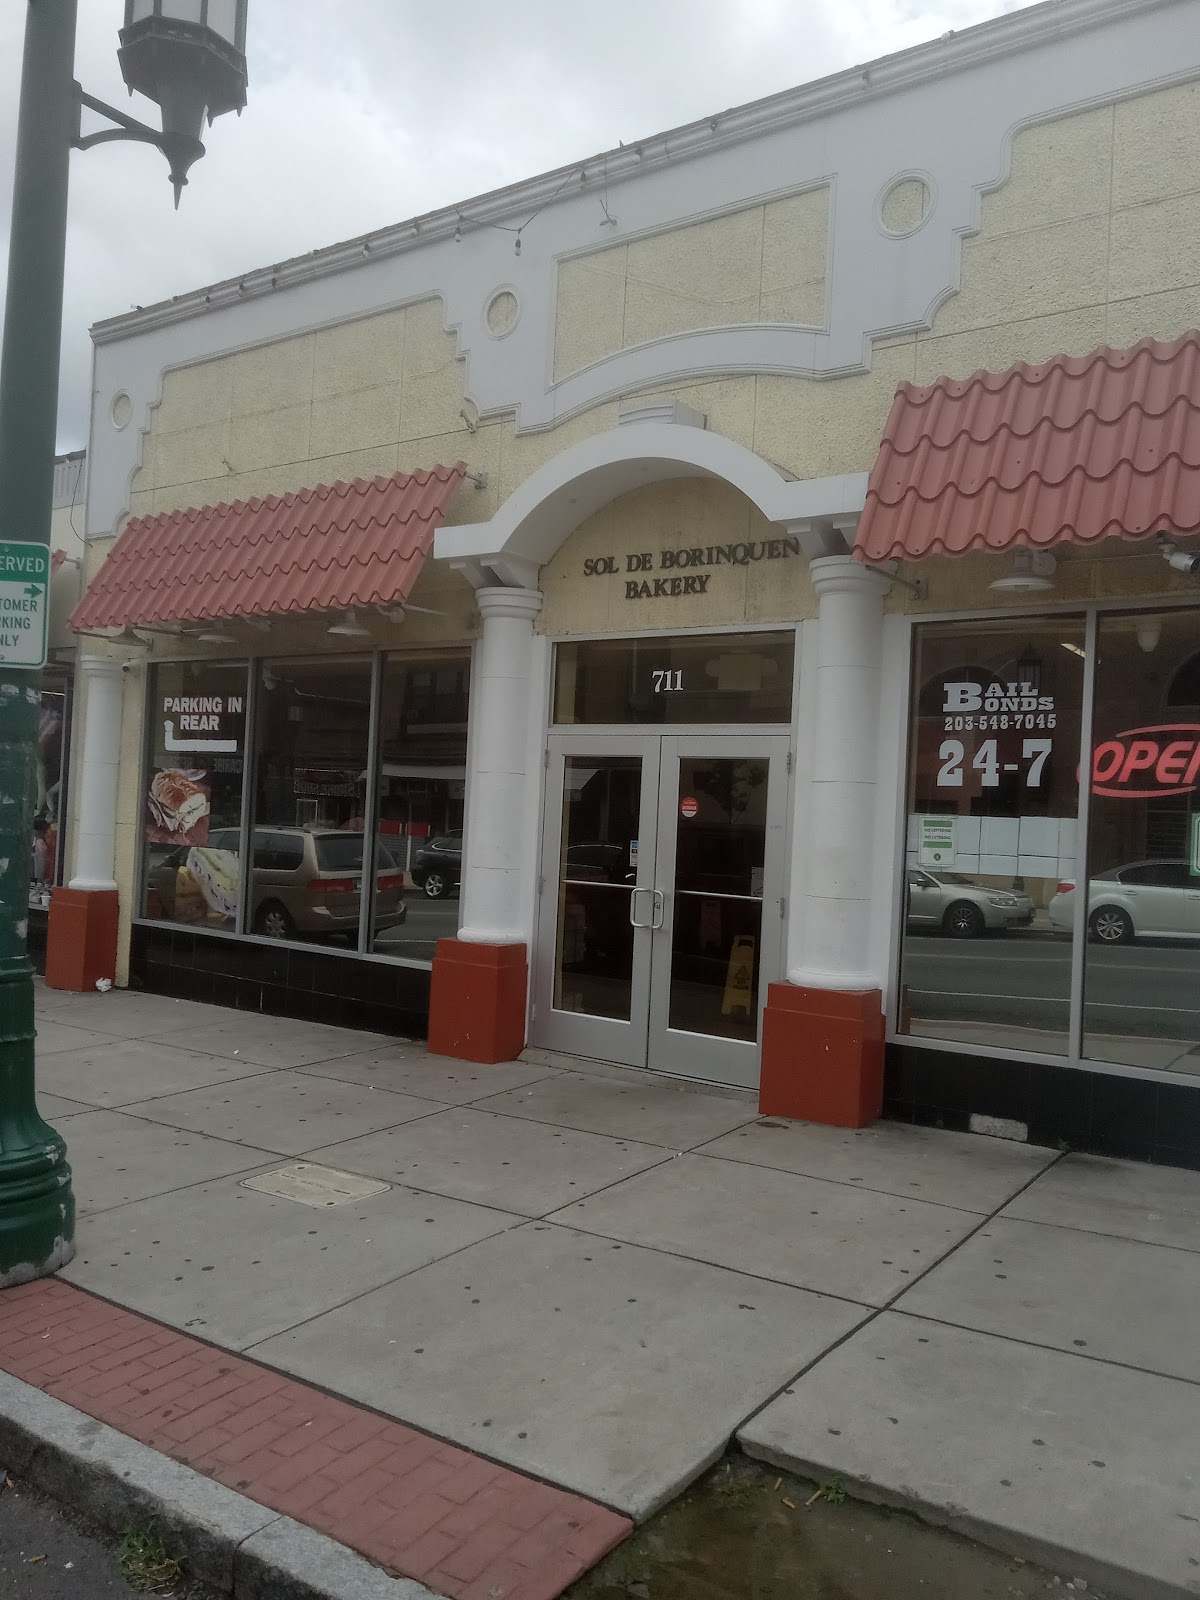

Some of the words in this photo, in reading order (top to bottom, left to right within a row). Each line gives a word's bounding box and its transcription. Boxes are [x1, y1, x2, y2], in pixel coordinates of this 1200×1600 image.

[583, 557, 619, 576] SOL
[626, 553, 653, 572] DE
[660, 537, 801, 570] BORINQUEN
[625, 574, 711, 599] BAKERY
[0, 615, 31, 630] KING
[652, 669, 684, 693] 711
[163, 696, 223, 713] PARKING
[227, 696, 242, 713] IN
[179, 715, 220, 731] REAR
[944, 713, 1057, 731] 203-548-7045
[936, 738, 1052, 787] 24-7
